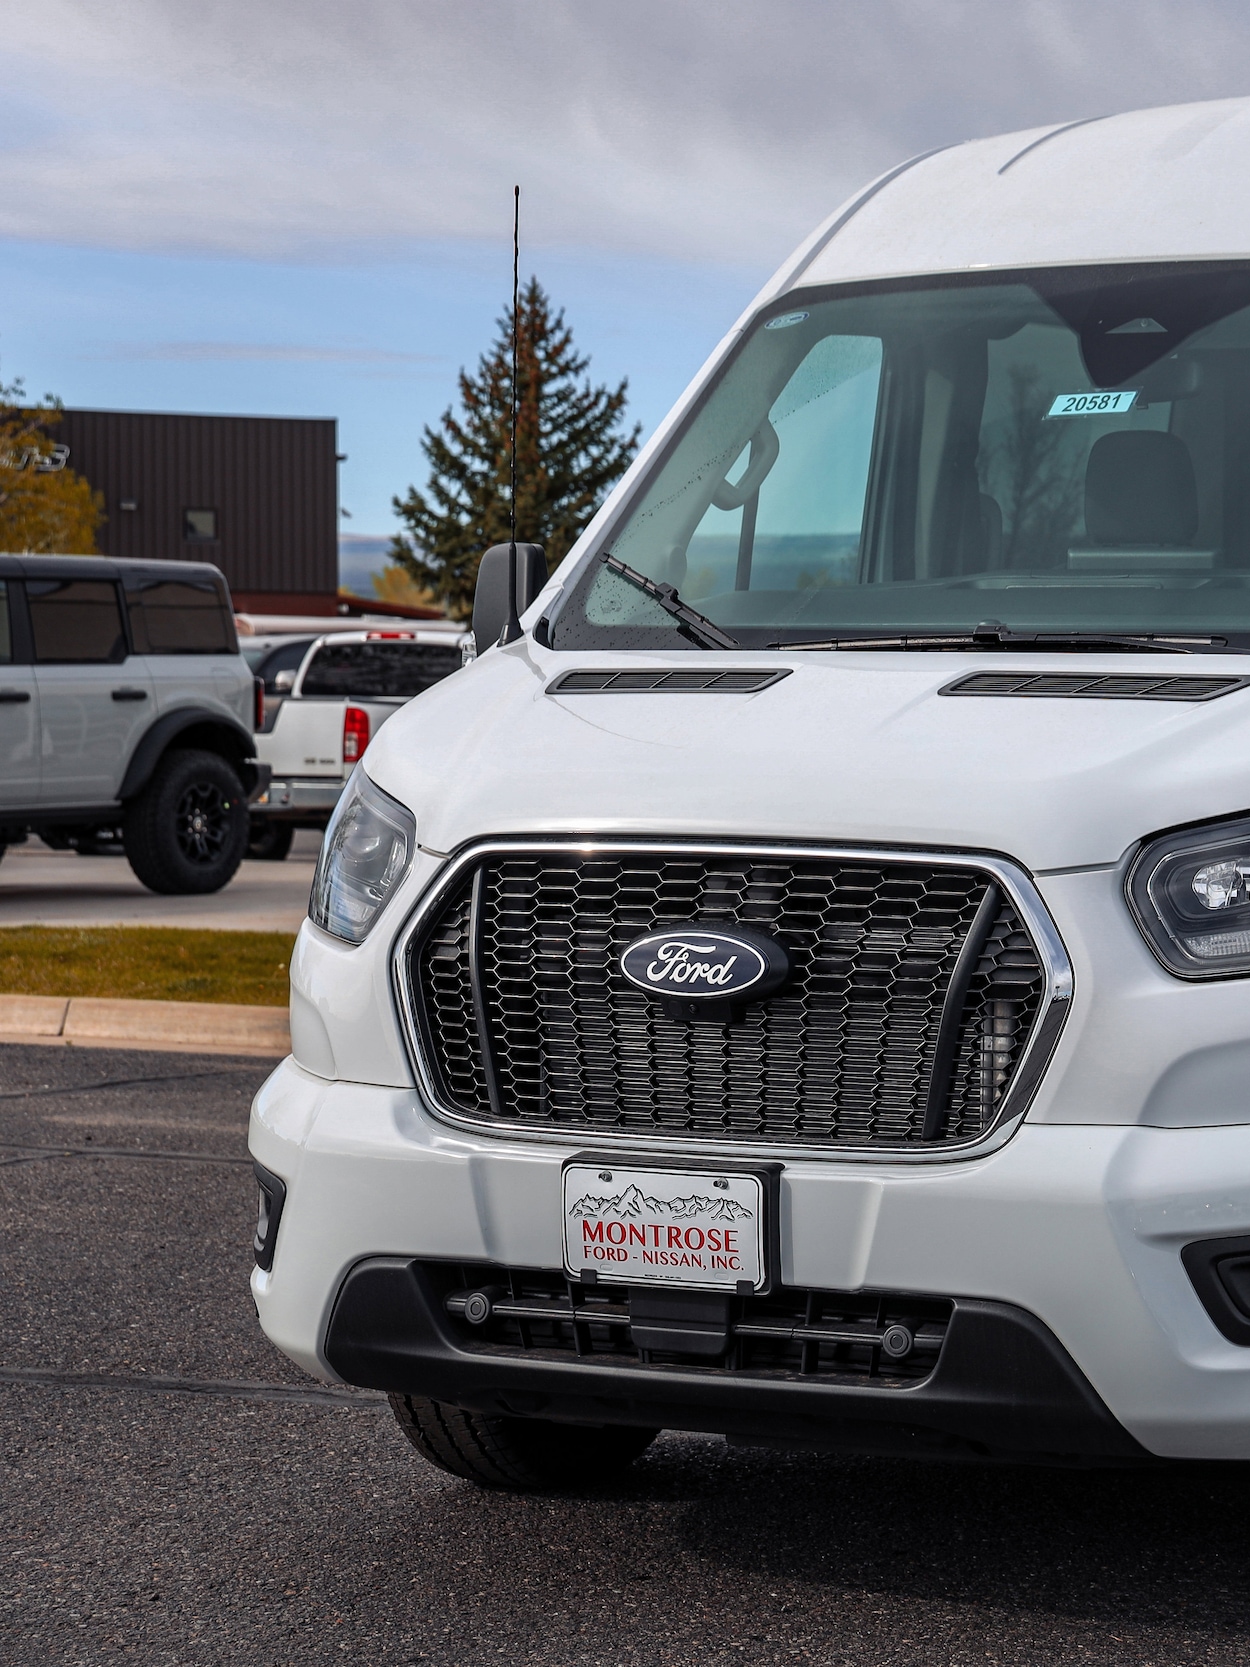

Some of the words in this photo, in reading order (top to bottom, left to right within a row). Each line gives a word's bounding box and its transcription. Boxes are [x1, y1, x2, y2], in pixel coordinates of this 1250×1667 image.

[1062, 394, 1121, 412] 20581
[647, 942, 737, 985] Ford
[582, 1220, 739, 1253] MONTROSE
[583, 1245, 628, 1262] FORD
[643, 1250, 707, 1271] NISSAN,
[711, 1255, 744, 1271] INC.
